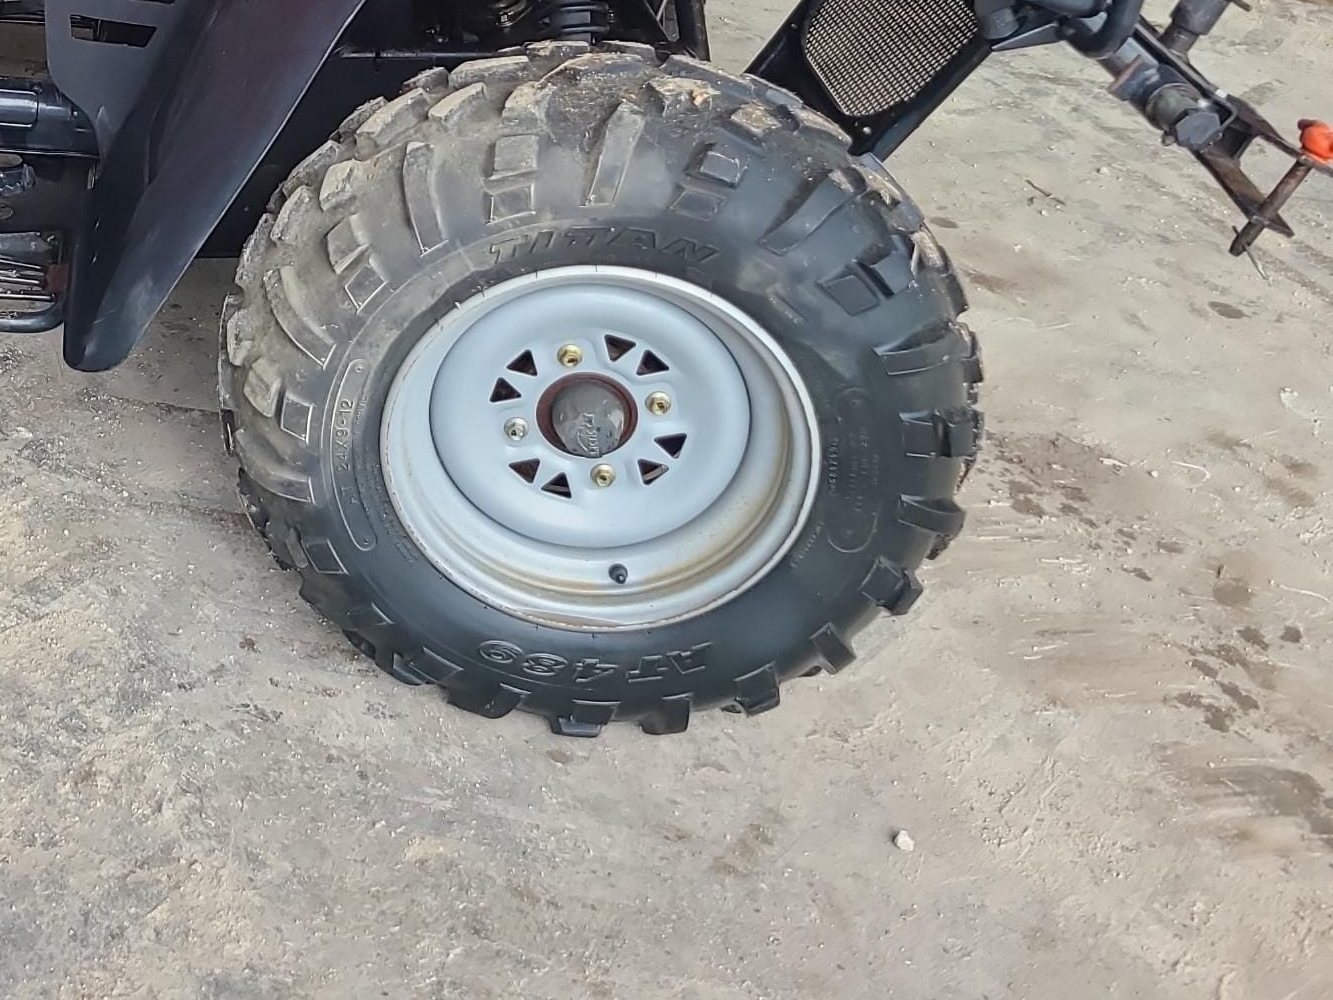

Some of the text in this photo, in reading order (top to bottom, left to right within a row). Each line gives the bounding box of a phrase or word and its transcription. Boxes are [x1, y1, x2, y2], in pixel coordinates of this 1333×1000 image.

[486, 225, 721, 266] TITAN
[334, 398, 354, 473] 24X9-12
[477, 638, 714, 684] AT489
